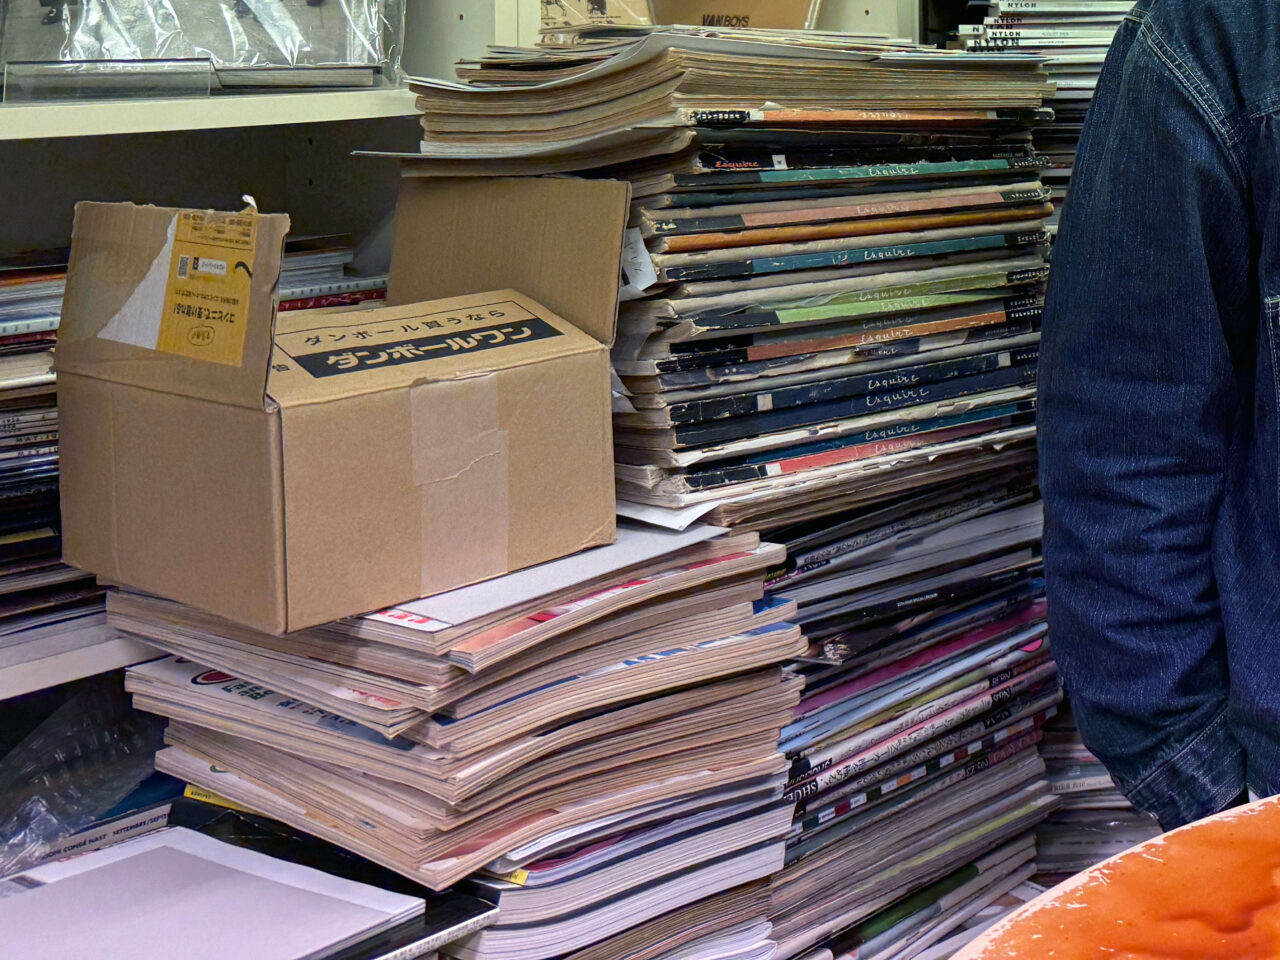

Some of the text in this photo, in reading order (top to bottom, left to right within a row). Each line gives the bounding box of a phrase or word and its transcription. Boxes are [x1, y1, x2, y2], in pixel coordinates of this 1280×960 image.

[702, 15, 722, 27] VAN
[974, 38, 1020, 46] NYLON
[715, 160, 758, 169] Esquire
[869, 167, 919, 177] Esquire
[856, 203, 909, 214] Esquire
[864, 249, 915, 259] Esquire
[859, 289, 911, 301] Esquire
[305, 309, 506, 347] ダンボール買うなら
[861, 329, 914, 344] Esquire
[327, 325, 533, 370] ダンボールワン
[868, 375, 919, 390] Esquire
[866, 389, 930, 407] Esquire
[865, 424, 920, 440] Esquire
[874, 439, 925, 453] Esquire
